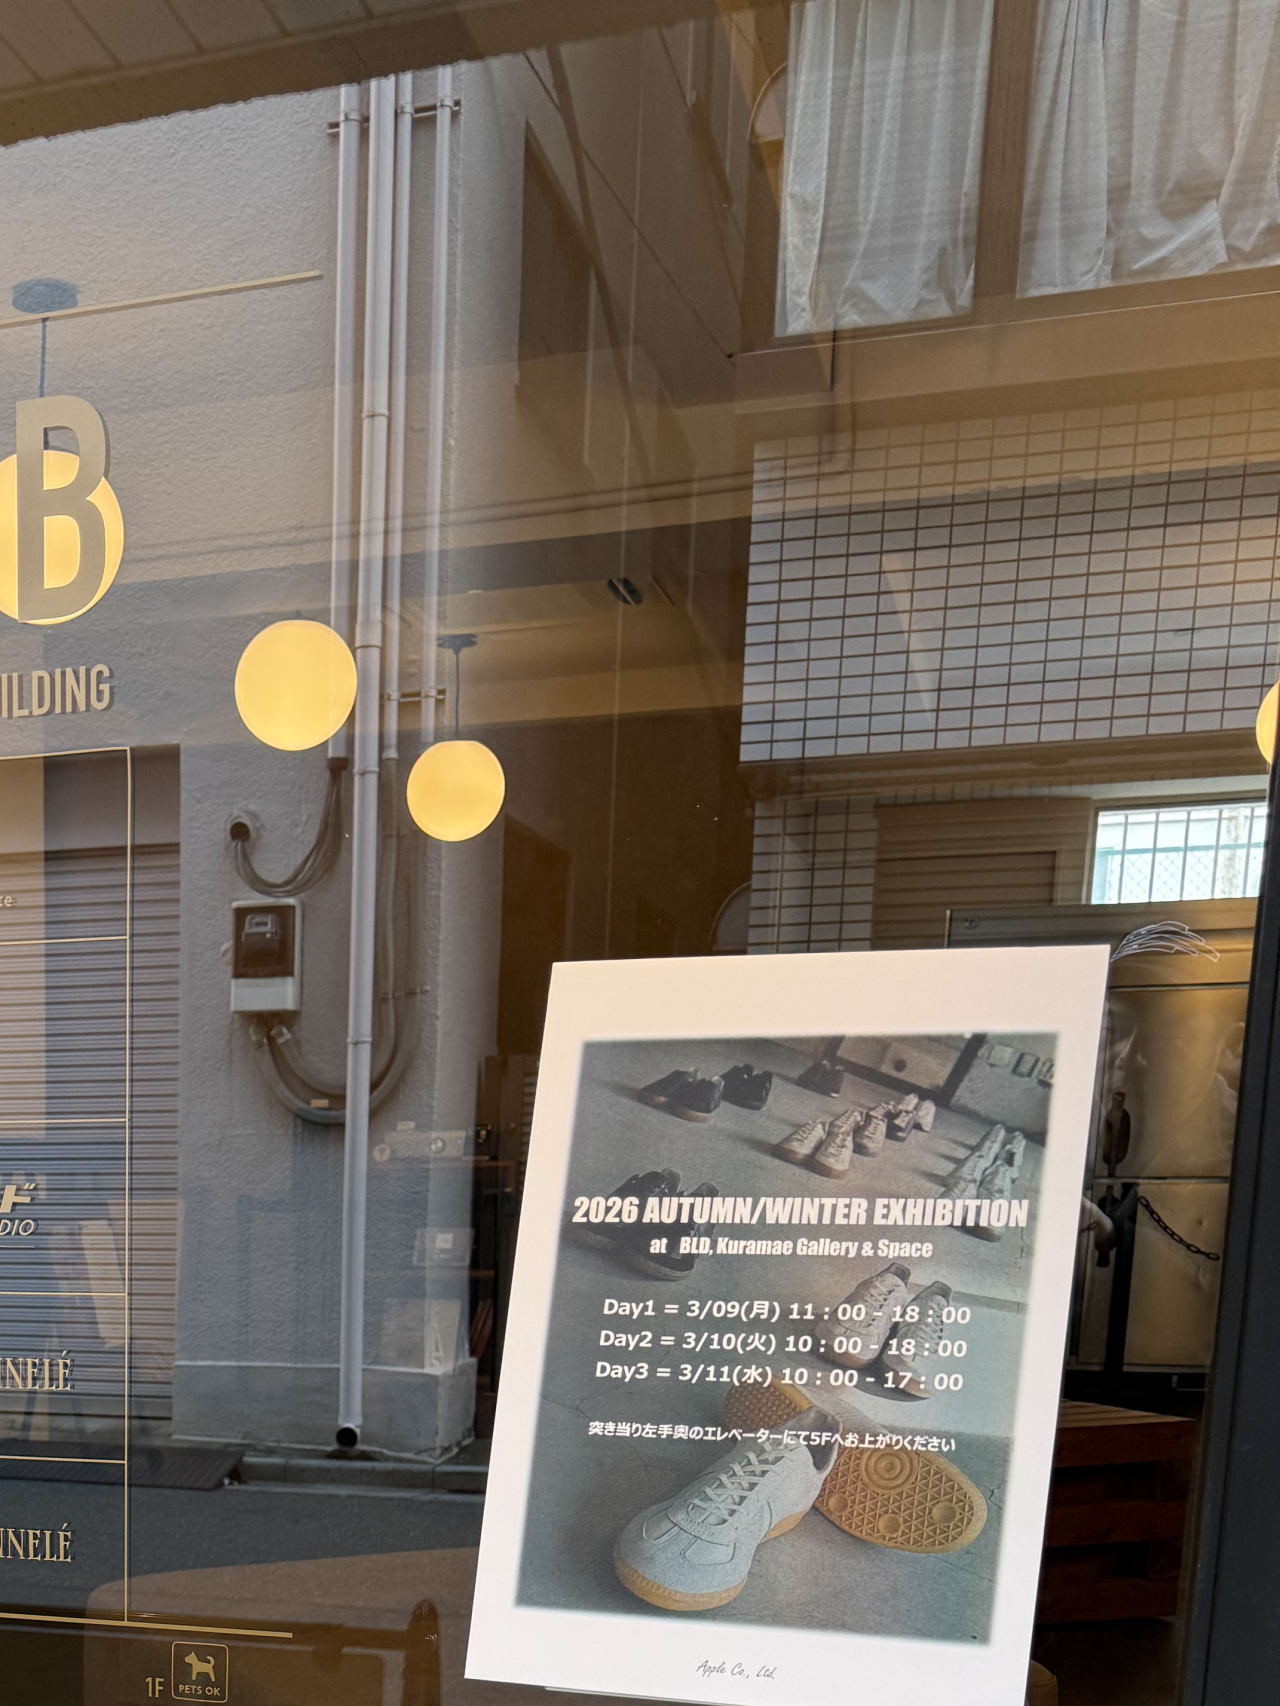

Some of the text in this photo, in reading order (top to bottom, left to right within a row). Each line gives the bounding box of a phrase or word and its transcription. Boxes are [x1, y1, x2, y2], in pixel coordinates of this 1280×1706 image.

[572, 1196, 1029, 1228] 2026 AUTUMN/WINTER EXHIBITION
[650, 1237, 667, 1254] at
[716, 1237, 793, 1256] Kuramae
[796, 1238, 859, 1259] Gallery
[861, 1240, 874, 1256] &
[877, 1239, 933, 1260] Space
[603, 1298, 656, 1319] Day1
[686, 1300, 781, 1322] 3/09(月)
[599, 1330, 653, 1351] Day2
[682, 1332, 777, 1355] 3/10(火)
[595, 1361, 649, 1382] Day3
[678, 1364, 773, 1387] 3/11(水)
[587, 1420, 956, 1453] 突き当り左手奥のエレベーターにて5Fへお上がりください
[696, 1659, 777, 1679] Apple Co., Ltd.
[145, 1676, 165, 1698] 1F
[178, 1684, 221, 1697] PETS OK
